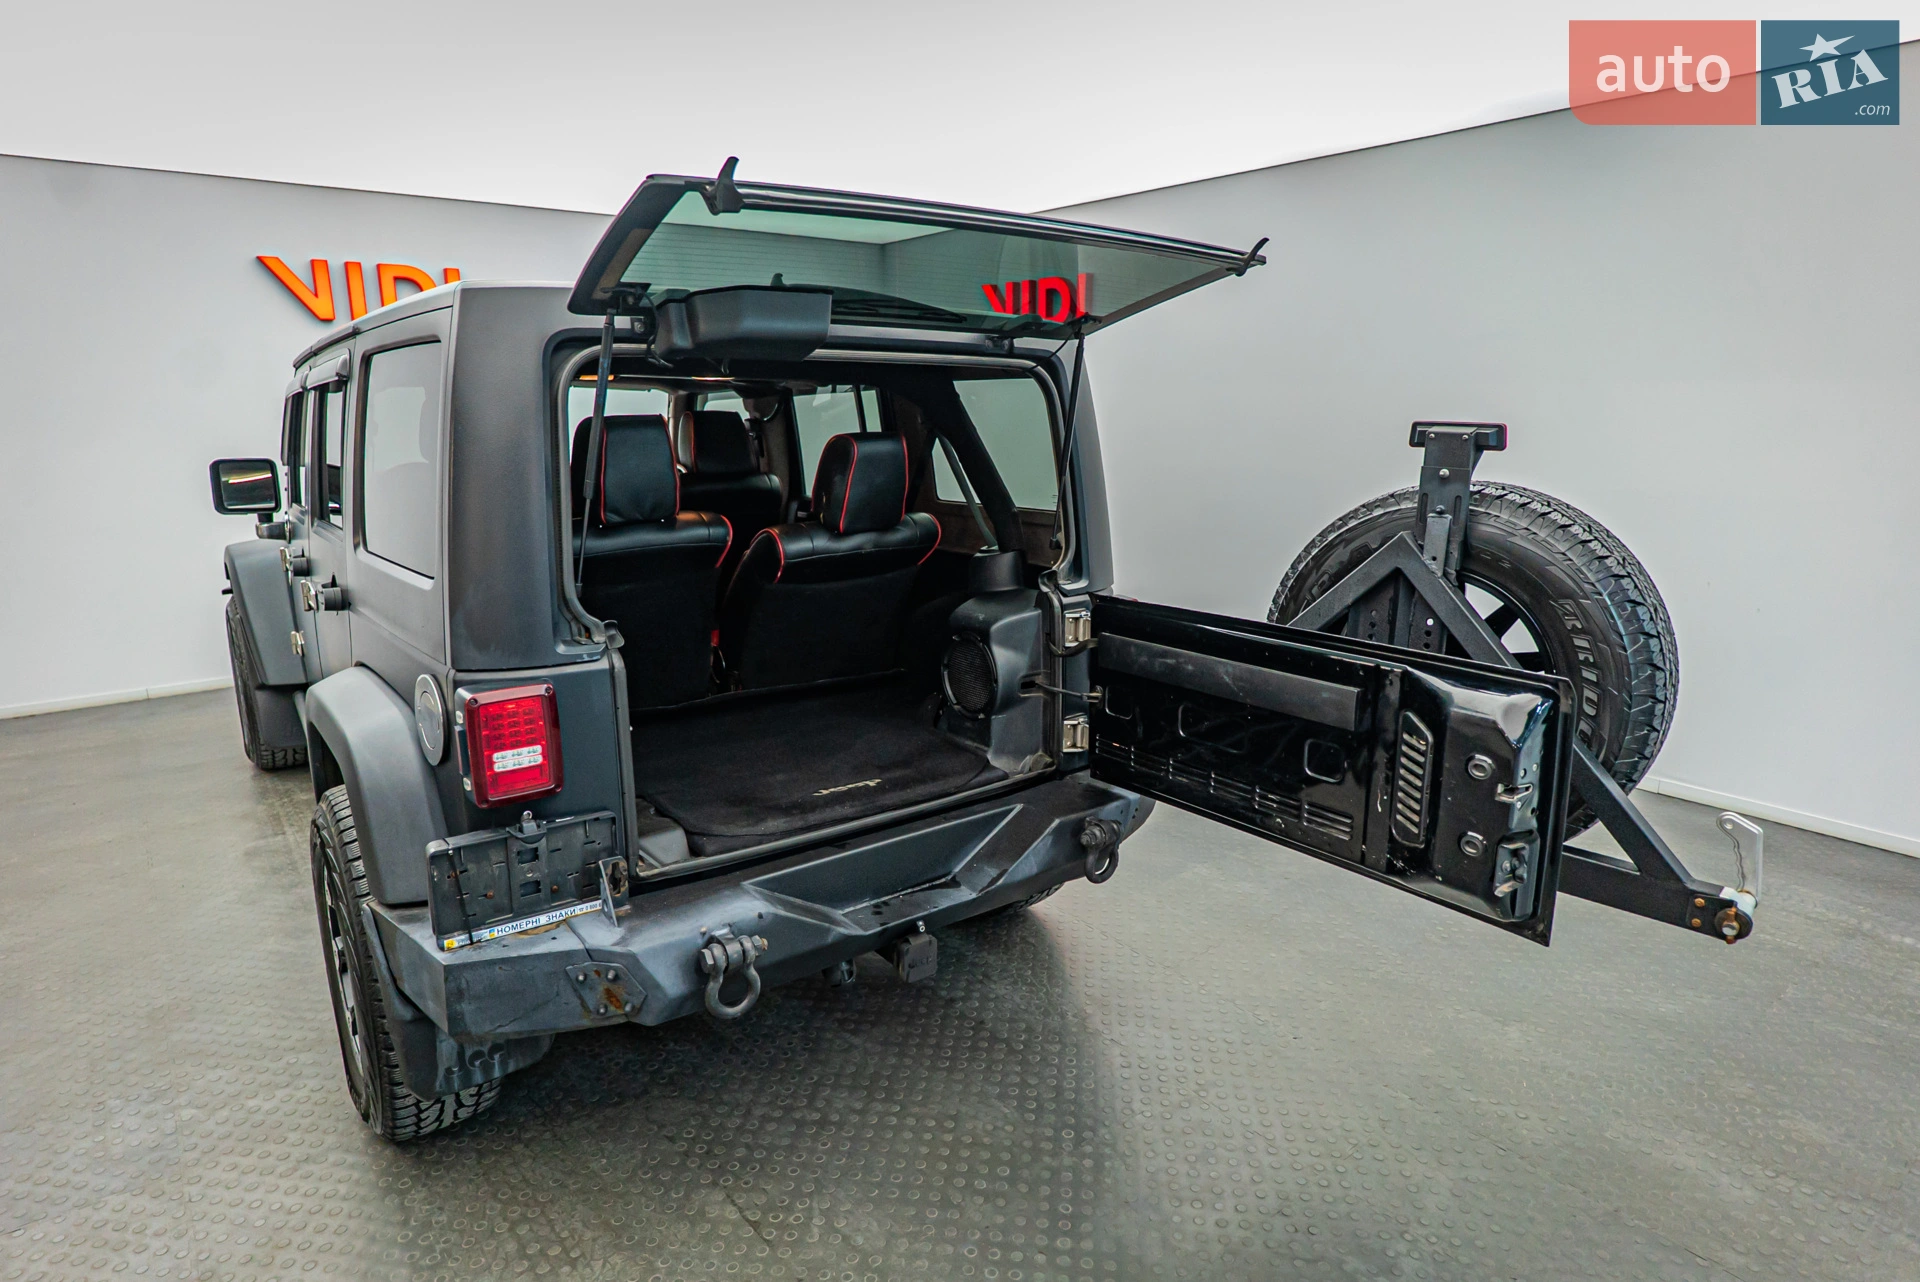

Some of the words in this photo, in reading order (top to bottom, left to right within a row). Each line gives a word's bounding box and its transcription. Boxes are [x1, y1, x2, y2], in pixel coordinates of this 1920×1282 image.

[256, 255, 462, 322] VID
[981, 272, 1090, 324] VIDI
[496, 917, 541, 936] НОМЕРНІ
[545, 908, 577, 923] ЗНАКИ
